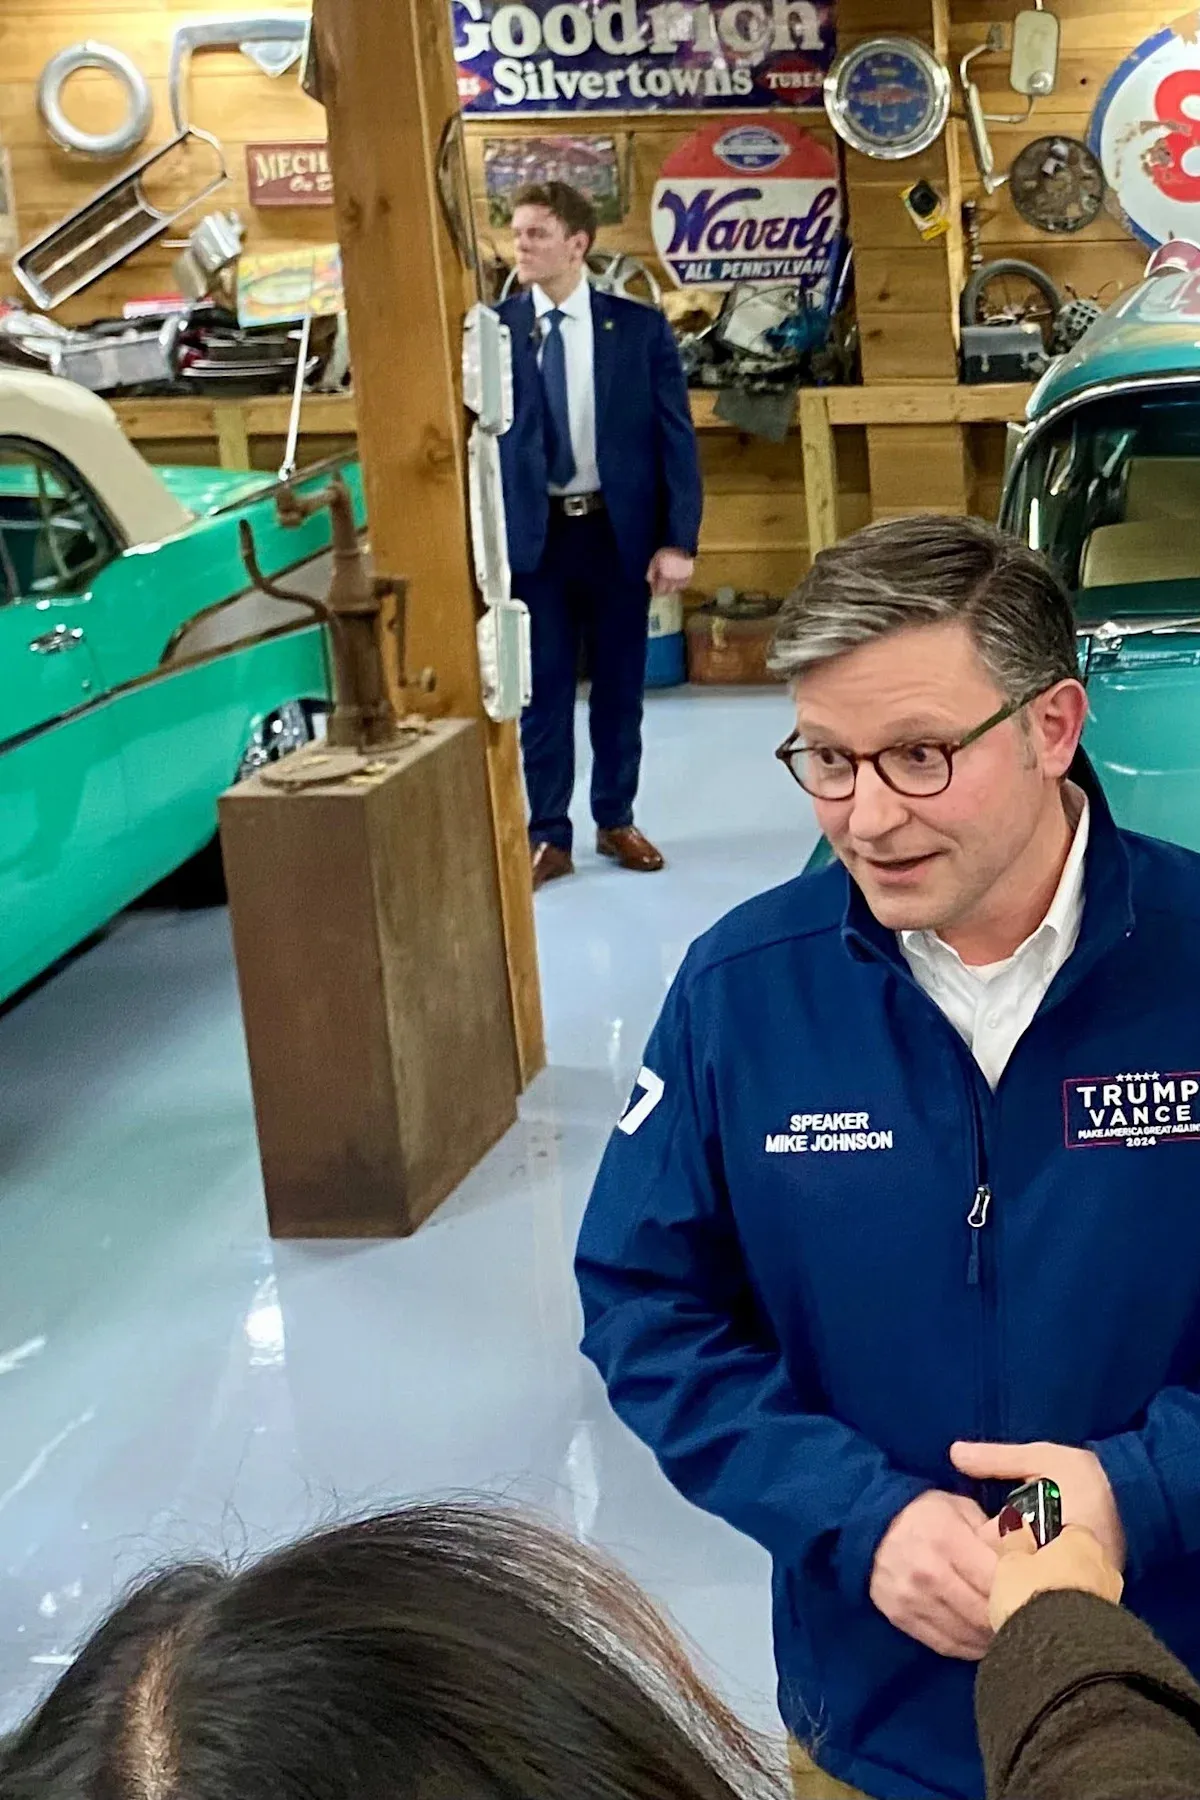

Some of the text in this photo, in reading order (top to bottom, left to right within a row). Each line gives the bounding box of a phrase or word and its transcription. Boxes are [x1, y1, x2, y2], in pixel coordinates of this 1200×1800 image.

[492, 57, 753, 106] Silvertowns
[658, 187, 838, 289] Waverly
[1076, 1080, 1199, 1108] TRUMP
[789, 1112, 869, 1132] SPEAKER
[1089, 1105, 1191, 1127] VANCE
[765, 1131, 893, 1152] MIKE JOHNSON
[1078, 1127, 1103, 1139] MAKE
[1104, 1126, 1144, 1138] AMERICA
[1144, 1125, 1171, 1136] GREAT
[1126, 1136, 1156, 1147] 2024
